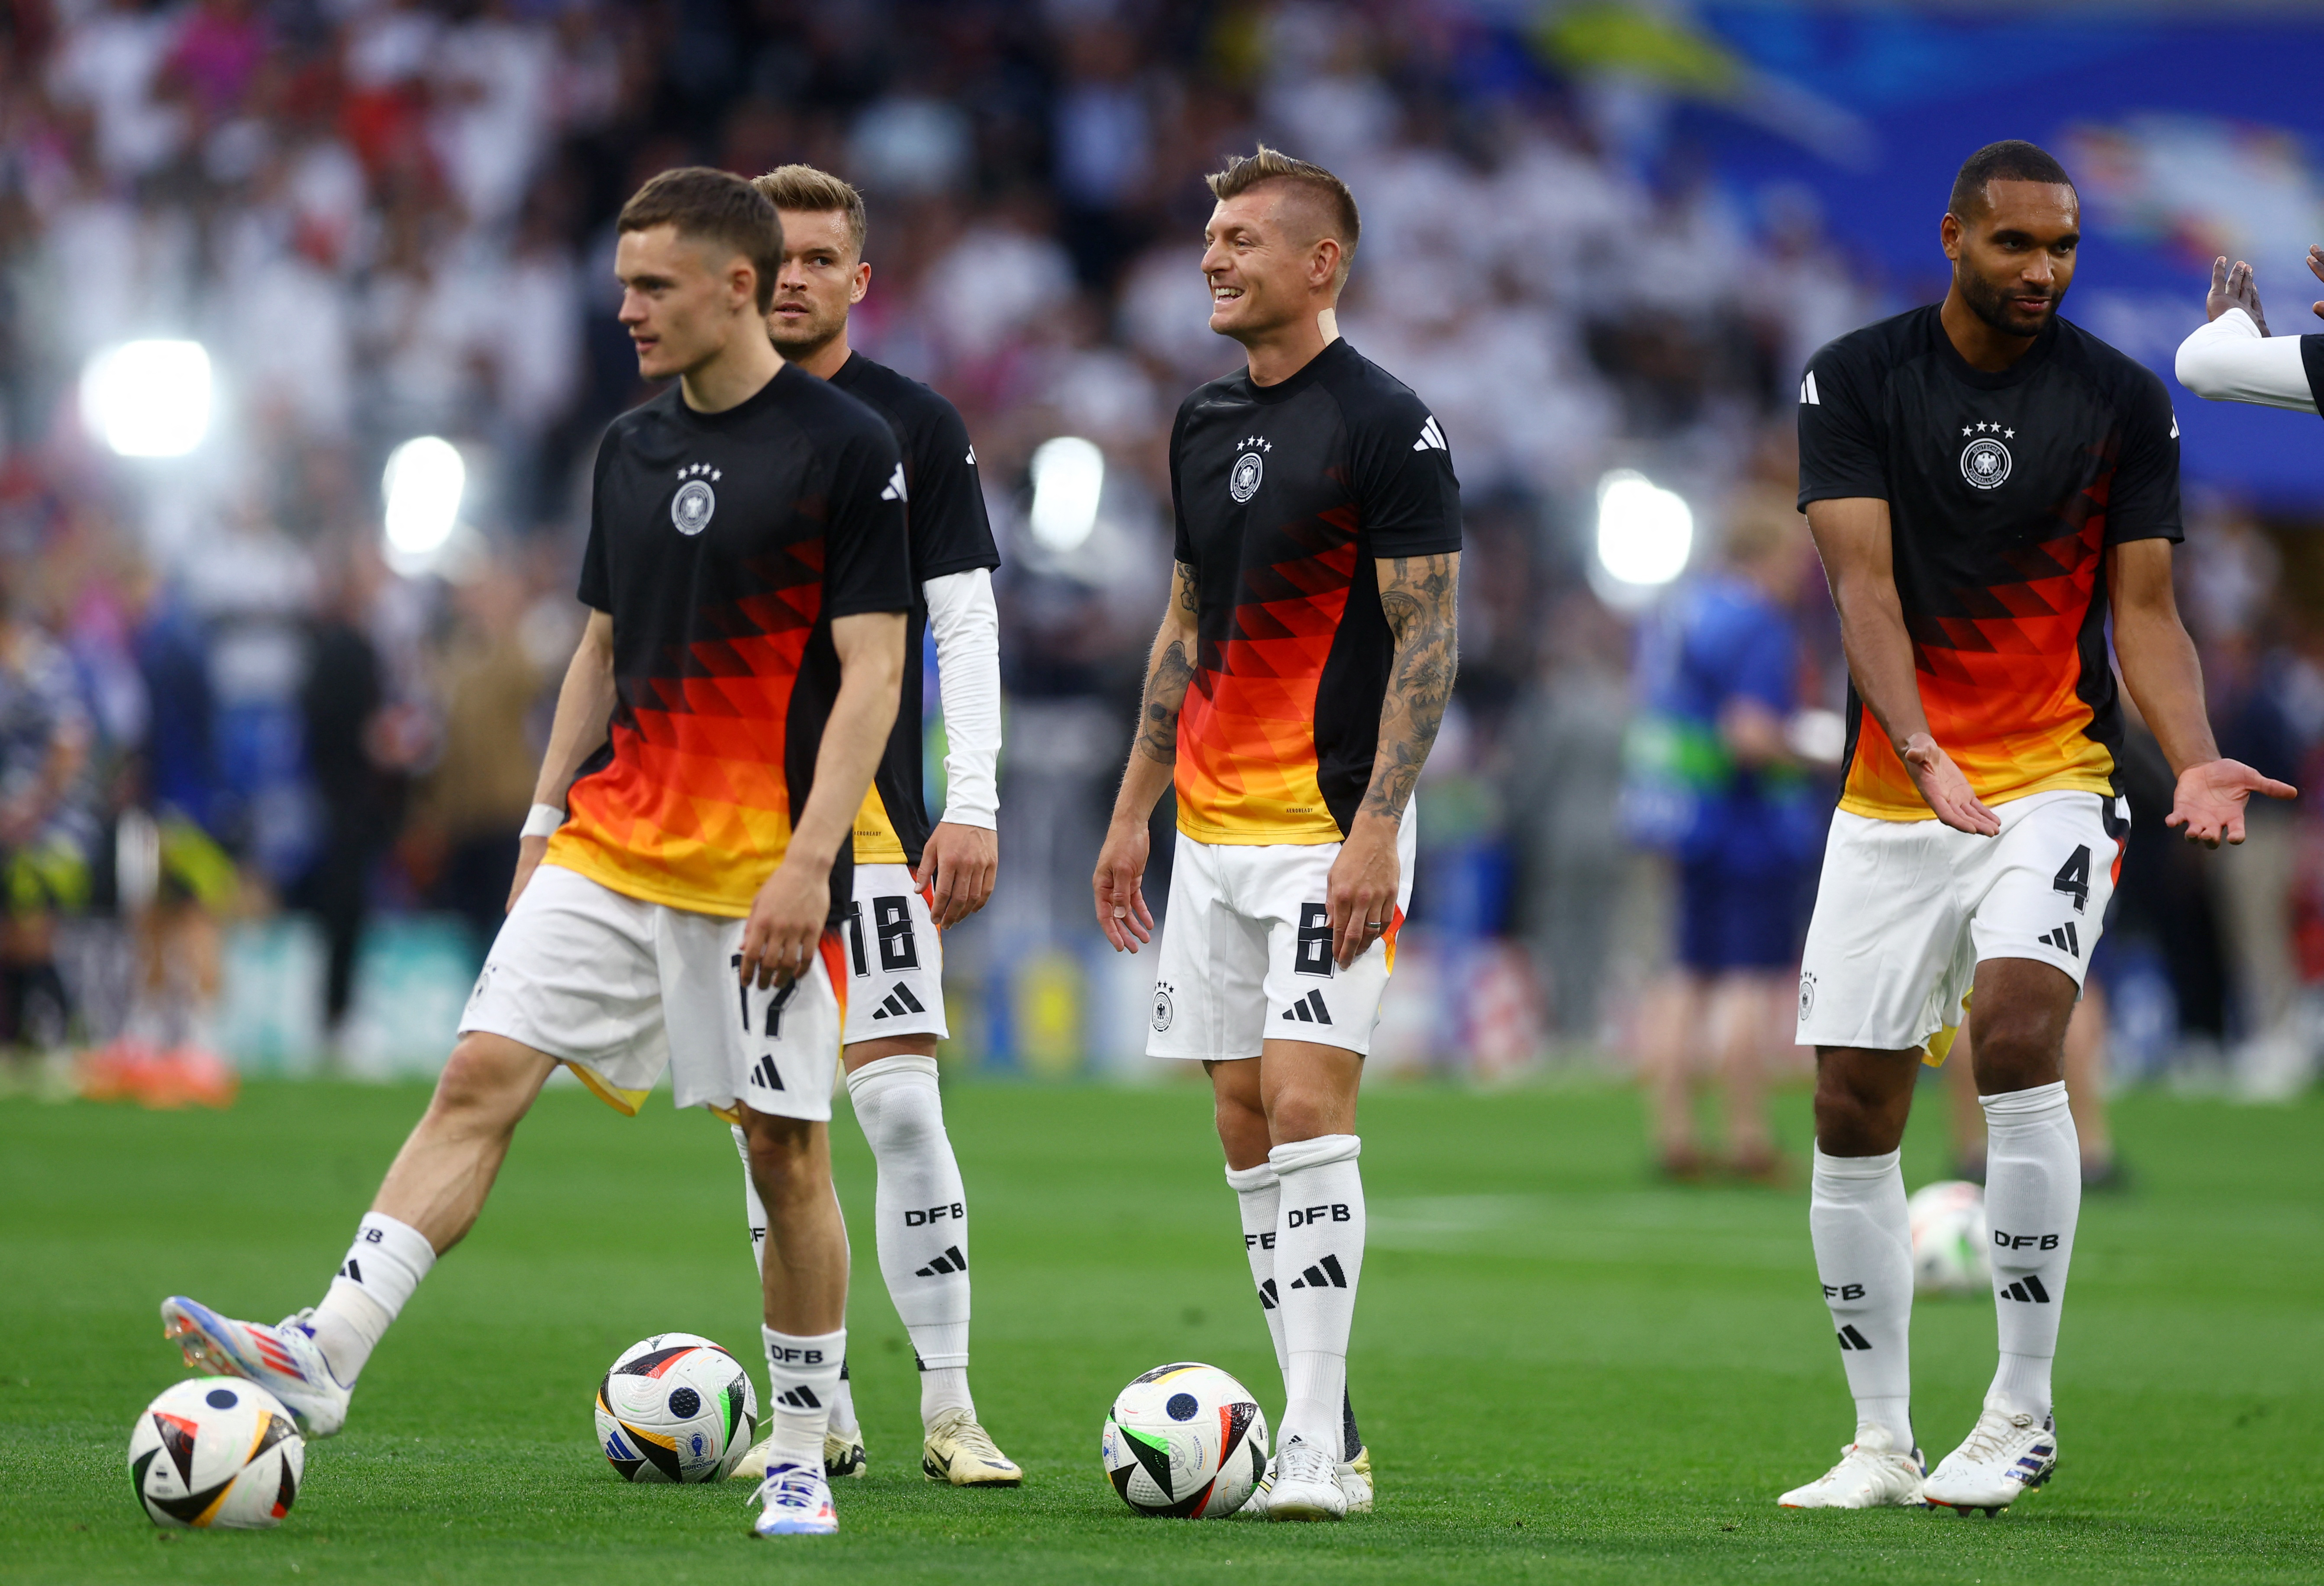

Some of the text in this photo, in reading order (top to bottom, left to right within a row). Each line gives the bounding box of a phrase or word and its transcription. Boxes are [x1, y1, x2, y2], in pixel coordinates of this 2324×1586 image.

[1972, 445, 2001, 455] DEUTSCHER
[1240, 459, 1258, 468] DEUTSCHER
[1969, 468, 2003, 483] FUSSBALL-BUND
[1235, 482, 1255, 496] FUSSBALL-BUND
[2053, 844, 2092, 915] 4
[849, 896, 921, 977] 18
[1294, 903, 1335, 979] 8
[905, 1202, 963, 1226] DFB
[1288, 1204, 1351, 1228] DFB
[1244, 1232, 1276, 1250] FB
[1994, 1230, 2059, 1250] DFB
[1822, 1284, 1866, 1300] FB
[771, 1344, 823, 1364] DFB
[1193, 1435, 1203, 1470] FUSSBALLLIEBE
